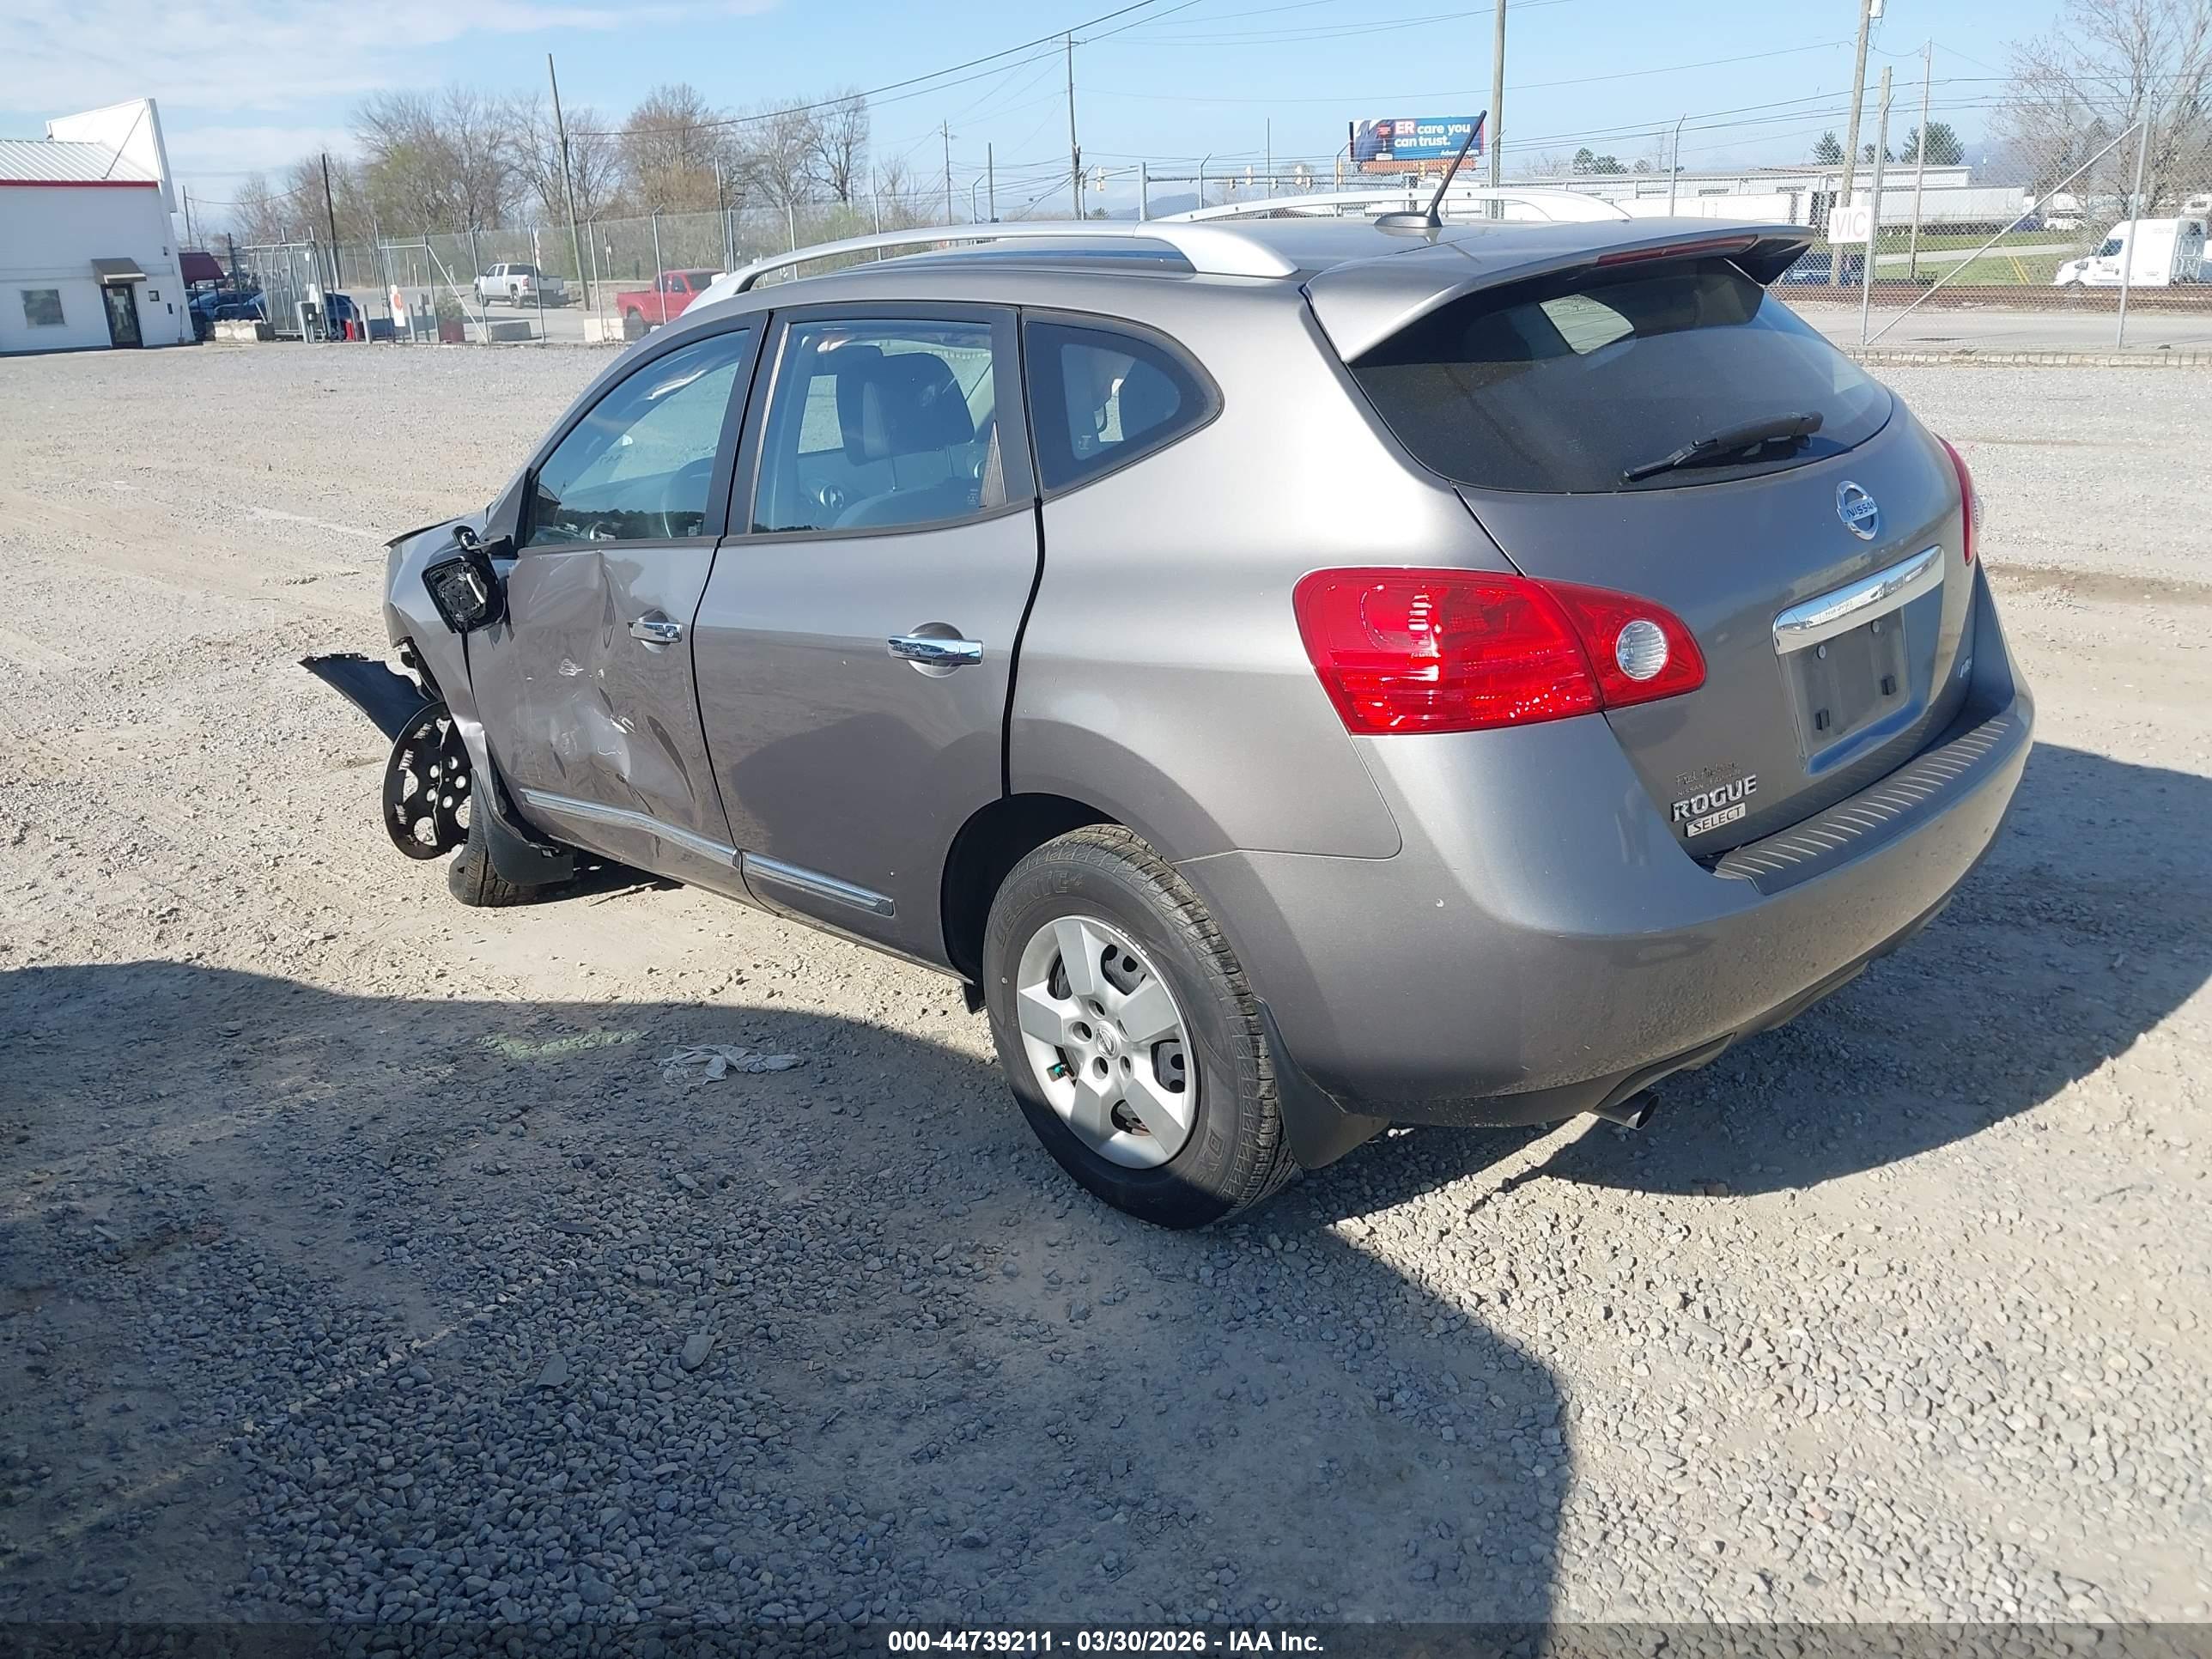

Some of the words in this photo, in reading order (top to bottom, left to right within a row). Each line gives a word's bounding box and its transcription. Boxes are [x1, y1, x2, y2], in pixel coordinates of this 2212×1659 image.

[1394, 137, 1417, 148] can
[1419, 136, 1451, 147] trust.
[1395, 121, 1415, 135] ER
[1417, 125, 1444, 135] care
[1447, 124, 1470, 137] you
[1834, 211, 1867, 238] VIC
[1673, 774, 1757, 822] ROGUE
[1692, 805, 1742, 833] SELECT
